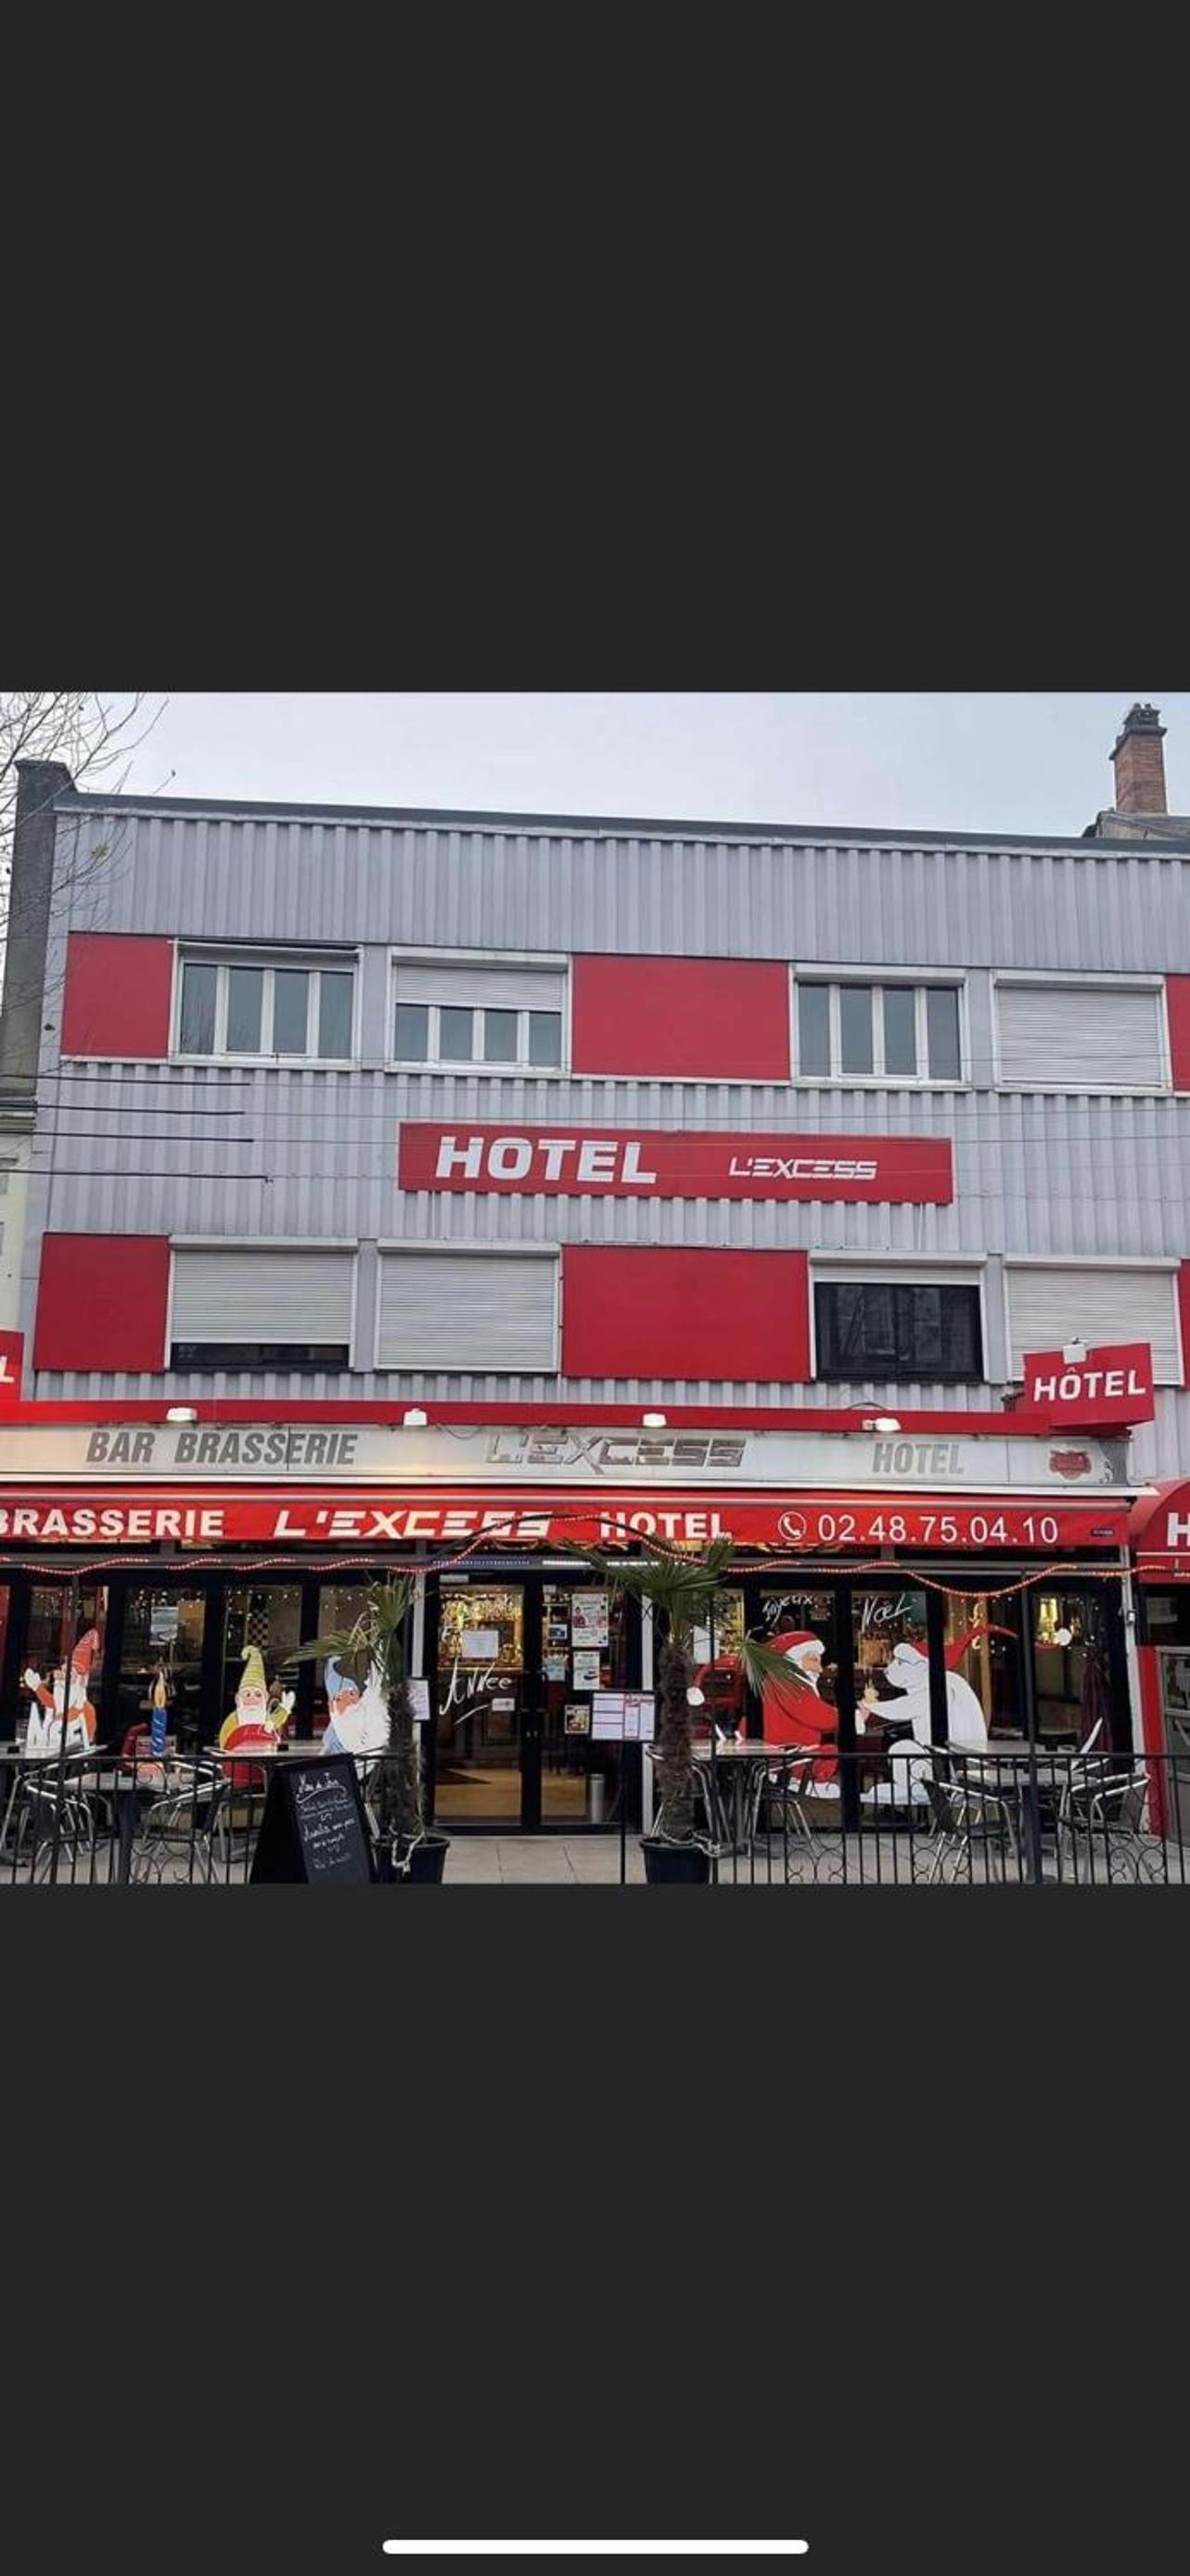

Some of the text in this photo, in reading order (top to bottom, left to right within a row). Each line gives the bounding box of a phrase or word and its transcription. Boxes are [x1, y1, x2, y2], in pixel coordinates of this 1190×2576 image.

[436, 1136, 877, 1184] HOTEL L'EXCESS
[1033, 1367, 1145, 1401] HÔTEL
[85, 1431, 358, 1465] BAR BRASSERIE
[872, 1443, 965, 1474] HOTEL
[273, 1510, 554, 1539] L'EXCESS
[600, 1511, 732, 1541] HOTEL
[817, 1513, 1059, 1544] 02.48.75.04.10
